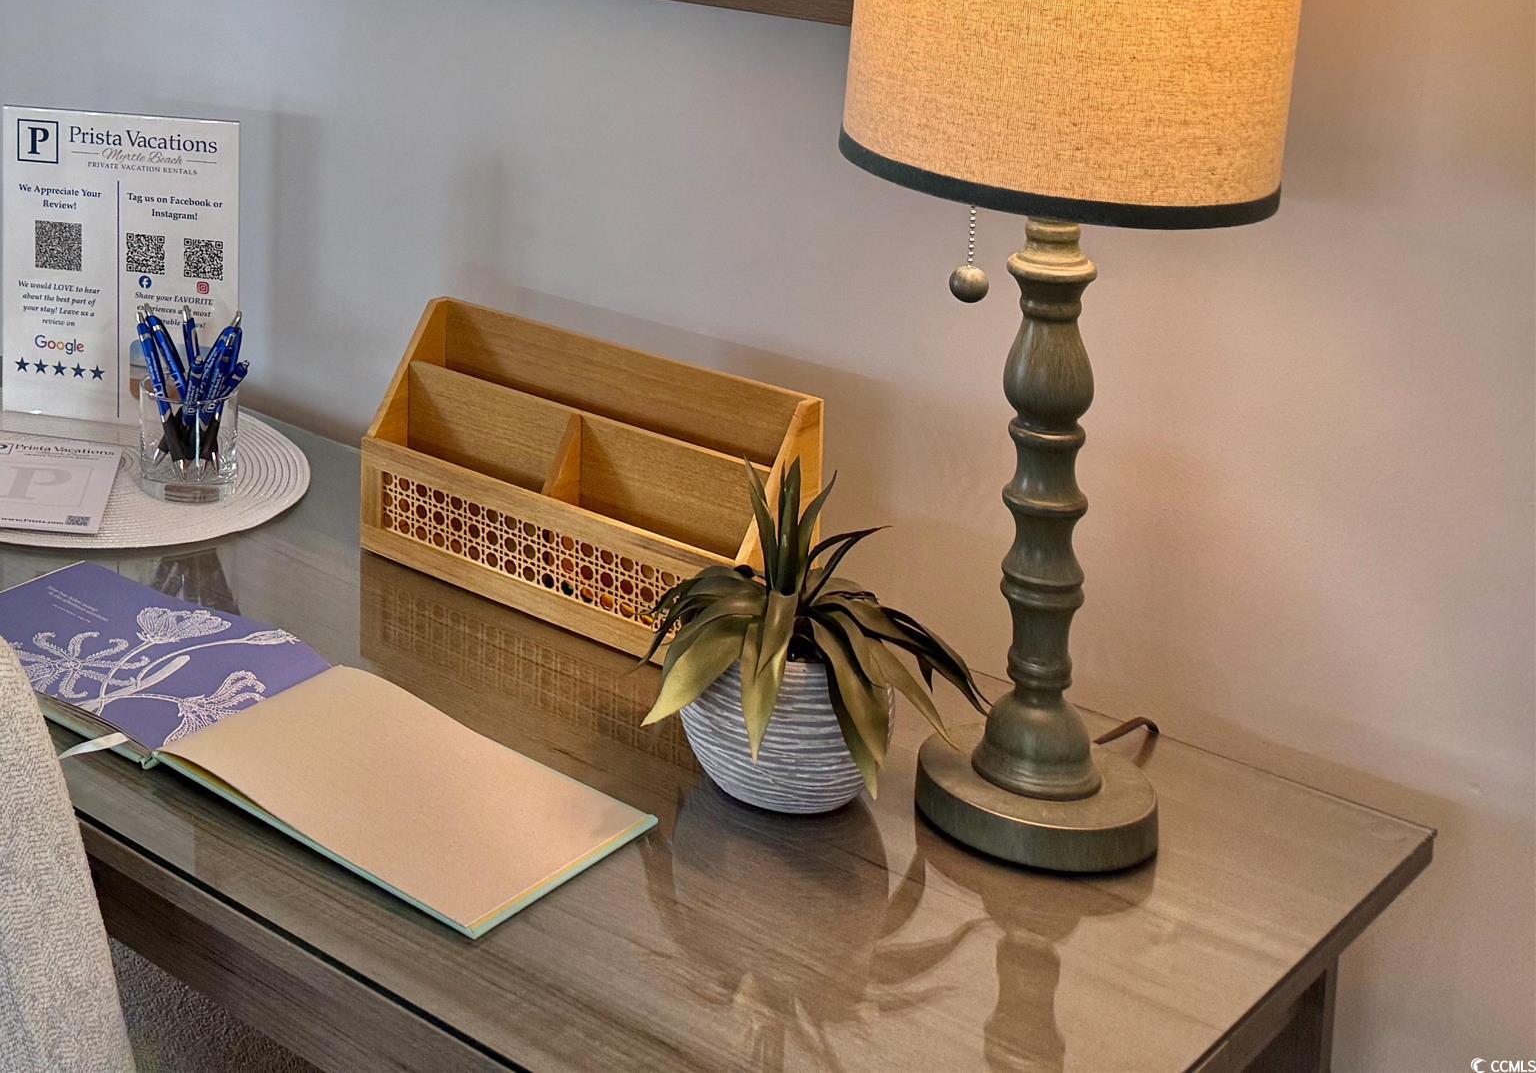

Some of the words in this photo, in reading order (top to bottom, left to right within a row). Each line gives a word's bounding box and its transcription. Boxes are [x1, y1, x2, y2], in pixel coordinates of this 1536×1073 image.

[27, 126, 50, 155] P
[68, 125, 123, 147] Prista
[125, 129, 218, 154] Vacations
[101, 147, 146, 164] Myrtle
[87, 161, 119, 170] PRIVATE
[121, 163, 161, 173] VACATION
[163, 167, 198, 175] RENTALS
[18, 183, 32, 192] We
[34, 185, 79, 197] Appreciate
[81, 188, 102, 198] Your
[42, 199, 77, 210] Review!
[127, 192, 143, 204] Tag
[170, 196, 211, 207] Facebook
[151, 208, 198, 221] Instagram!
[18, 280, 29, 288] We
[30, 282, 52, 290] would
[53, 283, 75, 292] LOVE
[22, 292, 43, 300] about
[44, 294, 55, 302] the
[56, 295, 70, 304] best
[71, 297, 87, 306] part
[87, 298, 97, 308] of
[135, 292, 155, 300] Share
[156, 295, 173, 303] your
[174, 295, 214, 306] FAVORITE
[23, 305, 39, 313] your
[59, 307, 80, 316] Leave
[193, 310, 211, 318] most
[34, 334, 85, 356] Google
